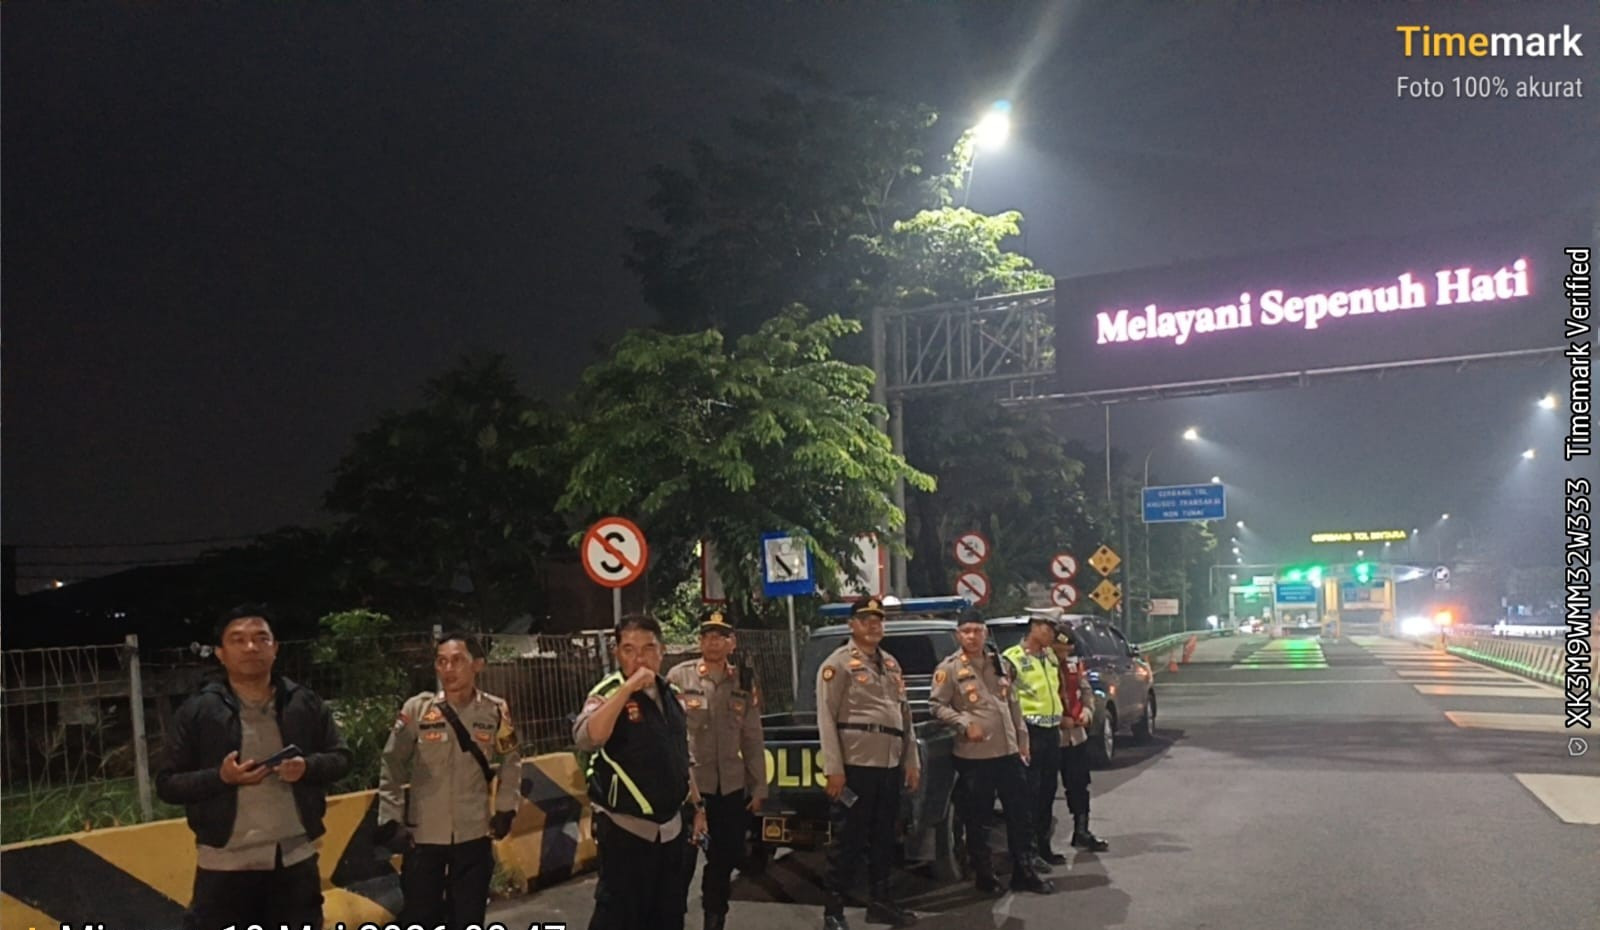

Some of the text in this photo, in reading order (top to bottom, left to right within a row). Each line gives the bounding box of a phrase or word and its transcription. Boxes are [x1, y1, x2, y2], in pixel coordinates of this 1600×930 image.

[1096, 258, 1529, 345] Melayani Sepenuh Hati
